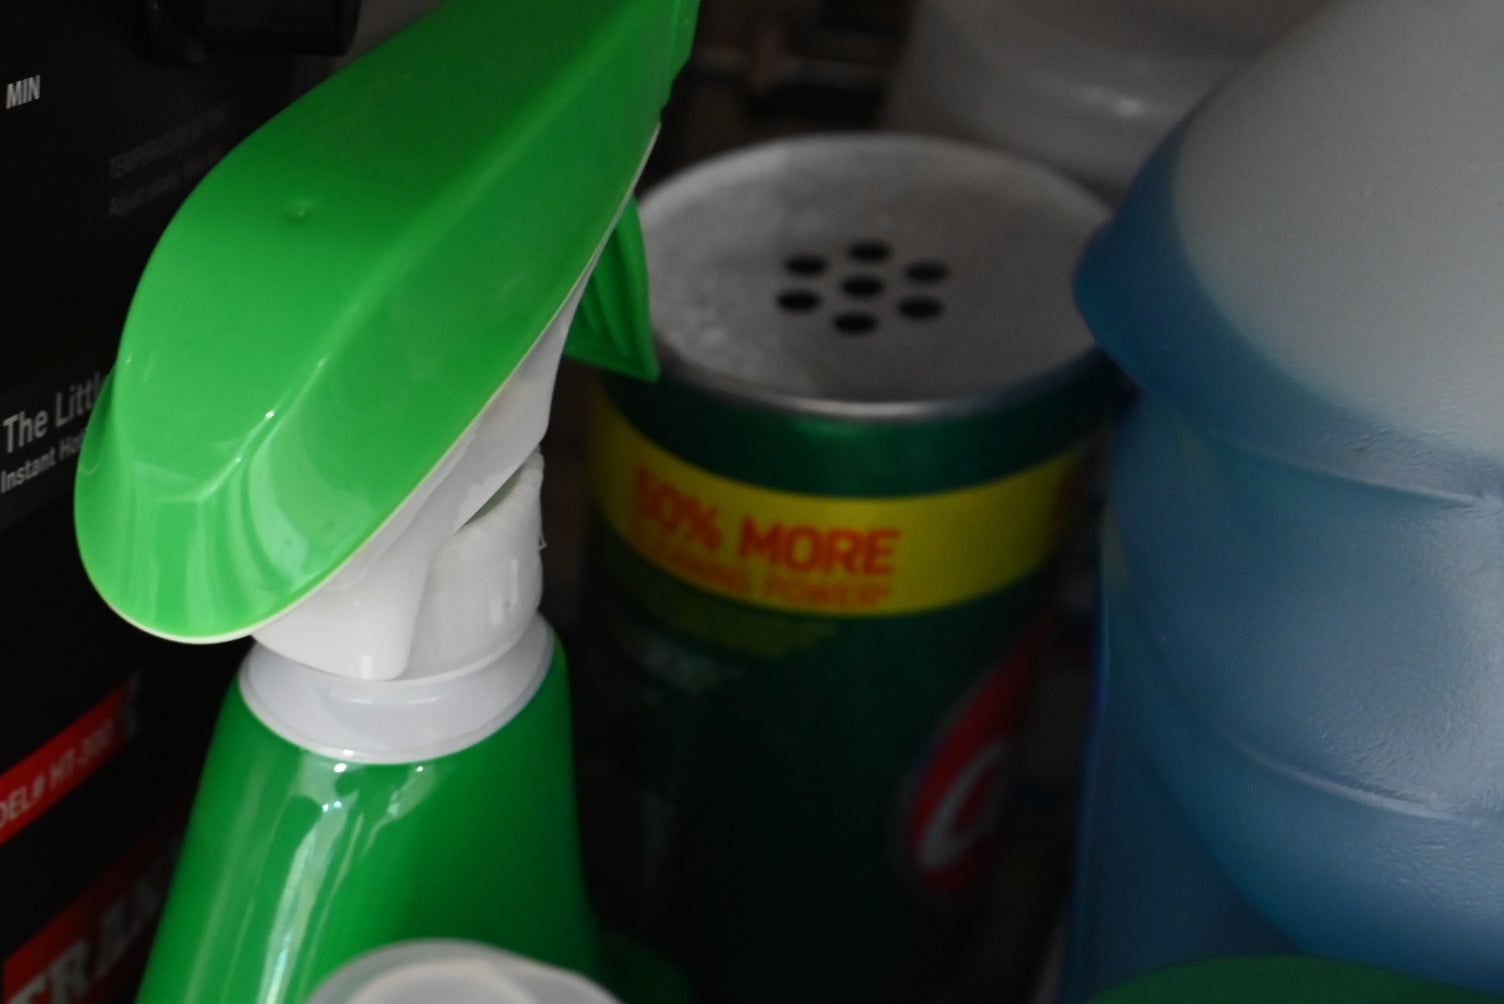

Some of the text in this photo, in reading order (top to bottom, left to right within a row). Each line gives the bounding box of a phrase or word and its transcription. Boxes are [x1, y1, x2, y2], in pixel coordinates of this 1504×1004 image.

[4, 73, 42, 110] MIN
[1, 370, 104, 454] The Littl
[0, 429, 86, 494] Instant Ho
[738, 515, 901, 577] MORE
